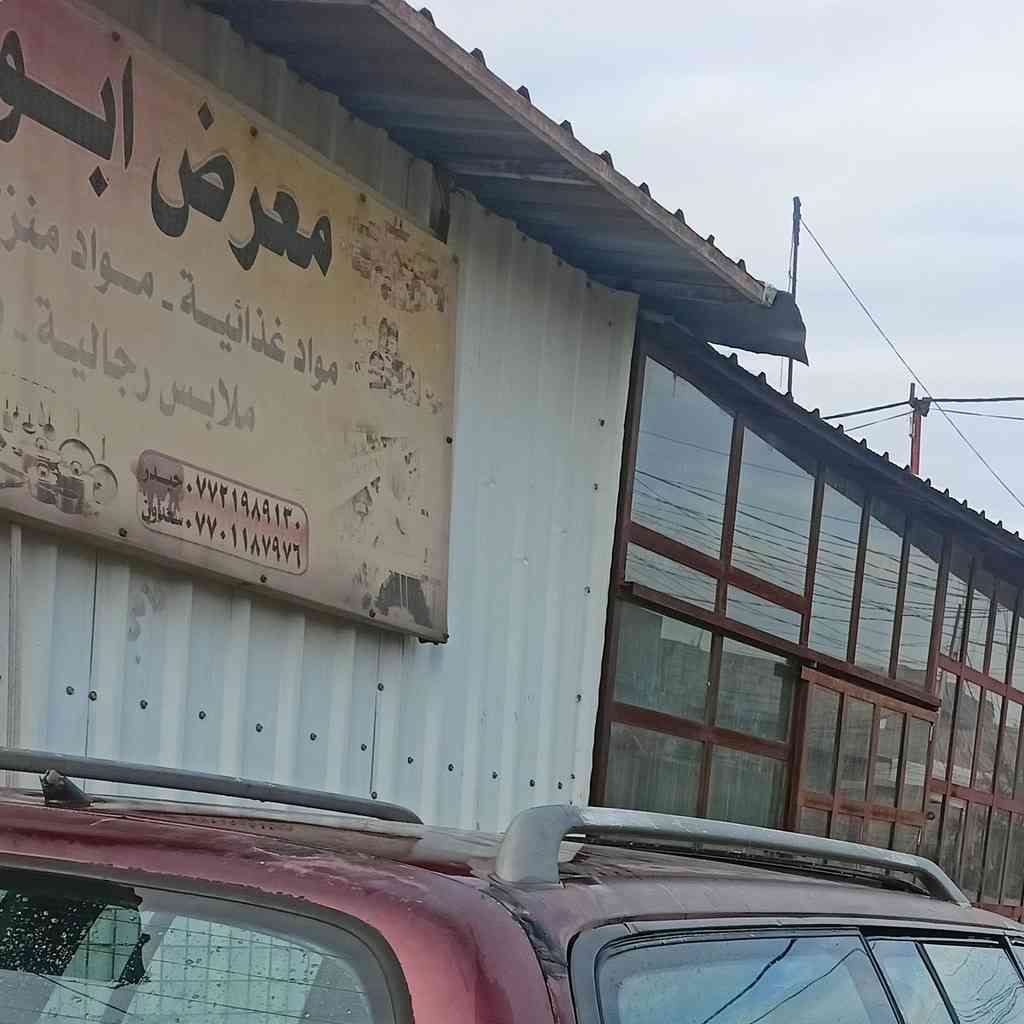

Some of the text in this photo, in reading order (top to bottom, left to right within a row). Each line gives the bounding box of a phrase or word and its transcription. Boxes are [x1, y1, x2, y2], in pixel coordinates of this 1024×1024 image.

[151, 100, 332, 278] معرض
[70, 226, 154, 300] مواد
[37, 295, 150, 402] رجالية
[180, 268, 286, 364] غذائية
[159, 376, 255, 432] ملابس
[293, 336, 338, 392] مواد
